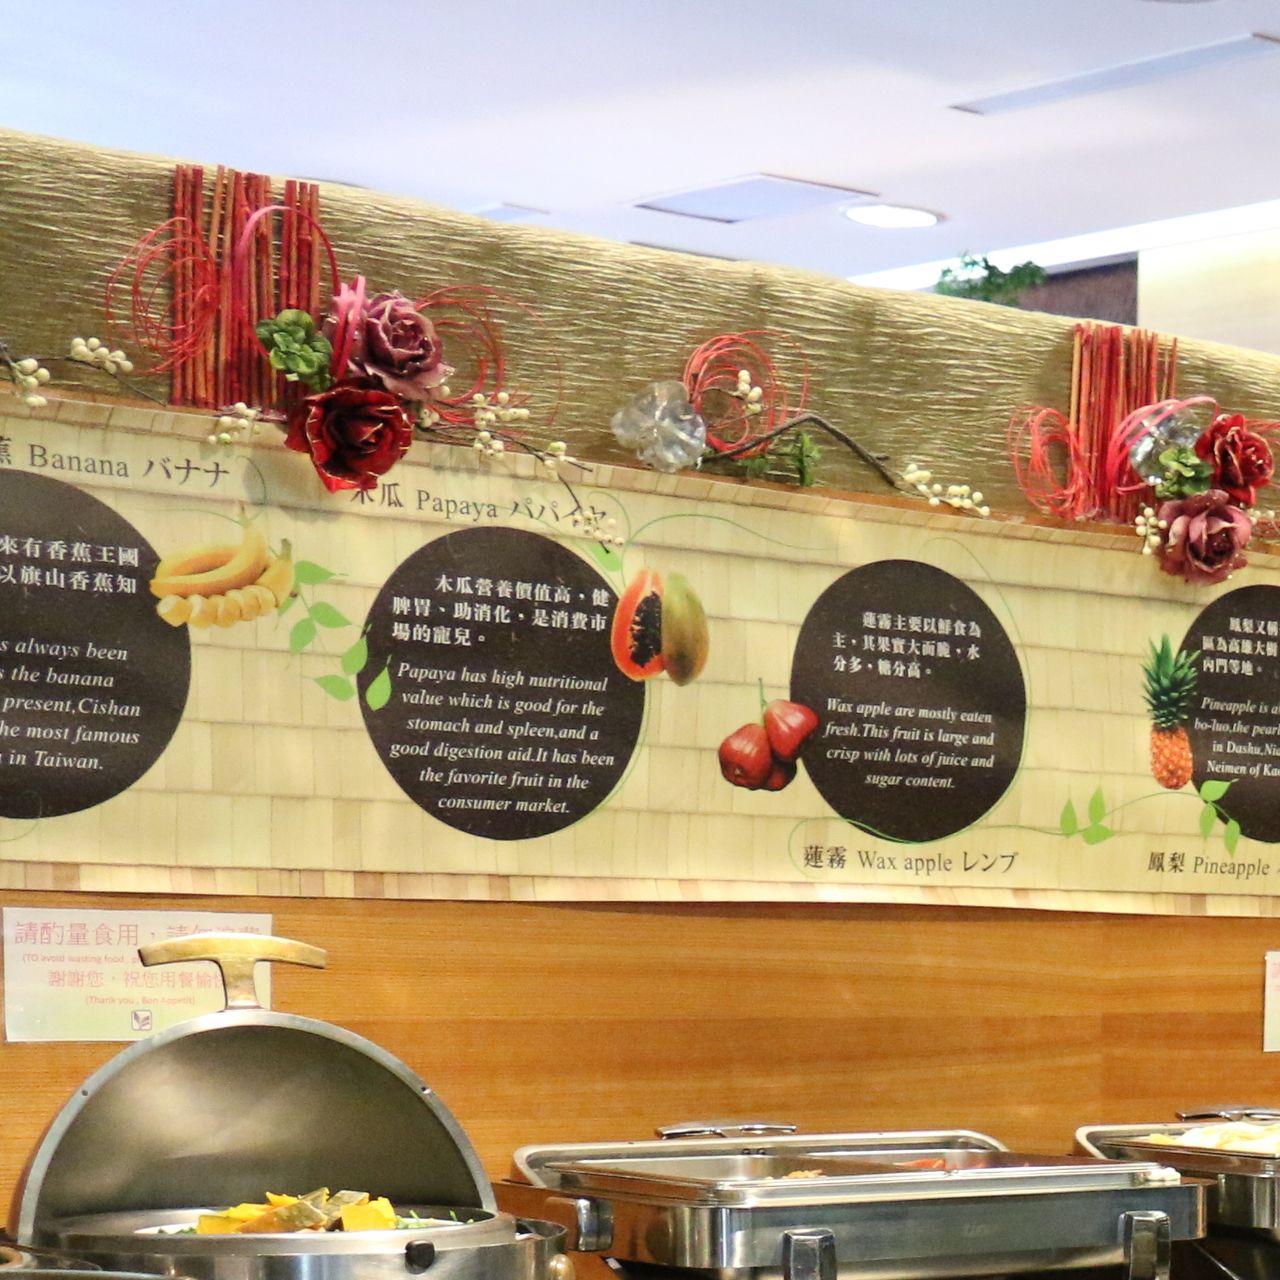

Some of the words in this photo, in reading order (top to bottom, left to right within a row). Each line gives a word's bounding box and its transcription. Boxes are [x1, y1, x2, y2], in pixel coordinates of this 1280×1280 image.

[29, 443, 129, 477] Banana
[143, 456, 230, 487] バナナ
[416, 489, 498, 521] Papaya
[15, 638, 80, 660] always
[86, 642, 128, 660] been
[11, 665, 40, 682] the
[46, 667, 114, 687] banana
[397, 662, 456, 683] Papaya
[461, 666, 487, 683] has
[491, 669, 524, 688] high
[529, 675, 608, 692] nutritional
[401, 689, 443, 705] value
[449, 693, 493, 709] which
[498, 696, 510, 710] is
[514, 697, 552, 715] good
[553, 699, 579, 716] for
[581, 701, 604, 716] the
[827, 697, 853, 713] Wax
[856, 701, 892, 718] apple
[894, 707, 916, 718] are
[918, 707, 957, 724] mostly
[960, 711, 993, 724] eaten
[1201, 696, 1255, 716] Pineapple
[1258, 701, 1269, 714] is
[26, 726, 69, 740] most
[72, 725, 140, 745] famous
[407, 717, 470, 733] stomach
[475, 720, 503, 735] and
[589, 729, 599, 741] a
[890, 726, 921, 742] fruit
[923, 729, 935, 741] is
[937, 730, 969, 747] large
[972, 732, 995, 746] and
[390, 742, 430, 758] good
[434, 742, 503, 761] digestion
[552, 749, 577, 765] has
[581, 750, 615, 766] been
[826, 746, 860, 764] crisp
[863, 748, 891, 762] with
[894, 748, 918, 764] lots
[921, 751, 937, 768] of
[936, 752, 968, 769] juice
[971, 755, 995, 768] and
[1212, 740, 1224, 753] in
[9, 751, 26, 765] in
[34, 750, 104, 770] Taiwan.
[1206, 760, 1247, 775] Neimen
[1249, 762, 1261, 778] of
[419, 766, 444, 782] the
[444, 768, 507, 786] favorite
[510, 771, 544, 789] fruit
[548, 774, 563, 788] in
[566, 774, 590, 789] the
[865, 773, 902, 789] sugar
[905, 774, 956, 789] content.
[438, 796, 512, 811] consumer
[515, 799, 571, 814] market.
[804, 845, 847, 870] 蓮霧
[857, 850, 899, 871] Wax
[904, 852, 953, 876] apple
[962, 851, 1019, 874] レンブ
[1193, 856, 1270, 881] Pineapple
